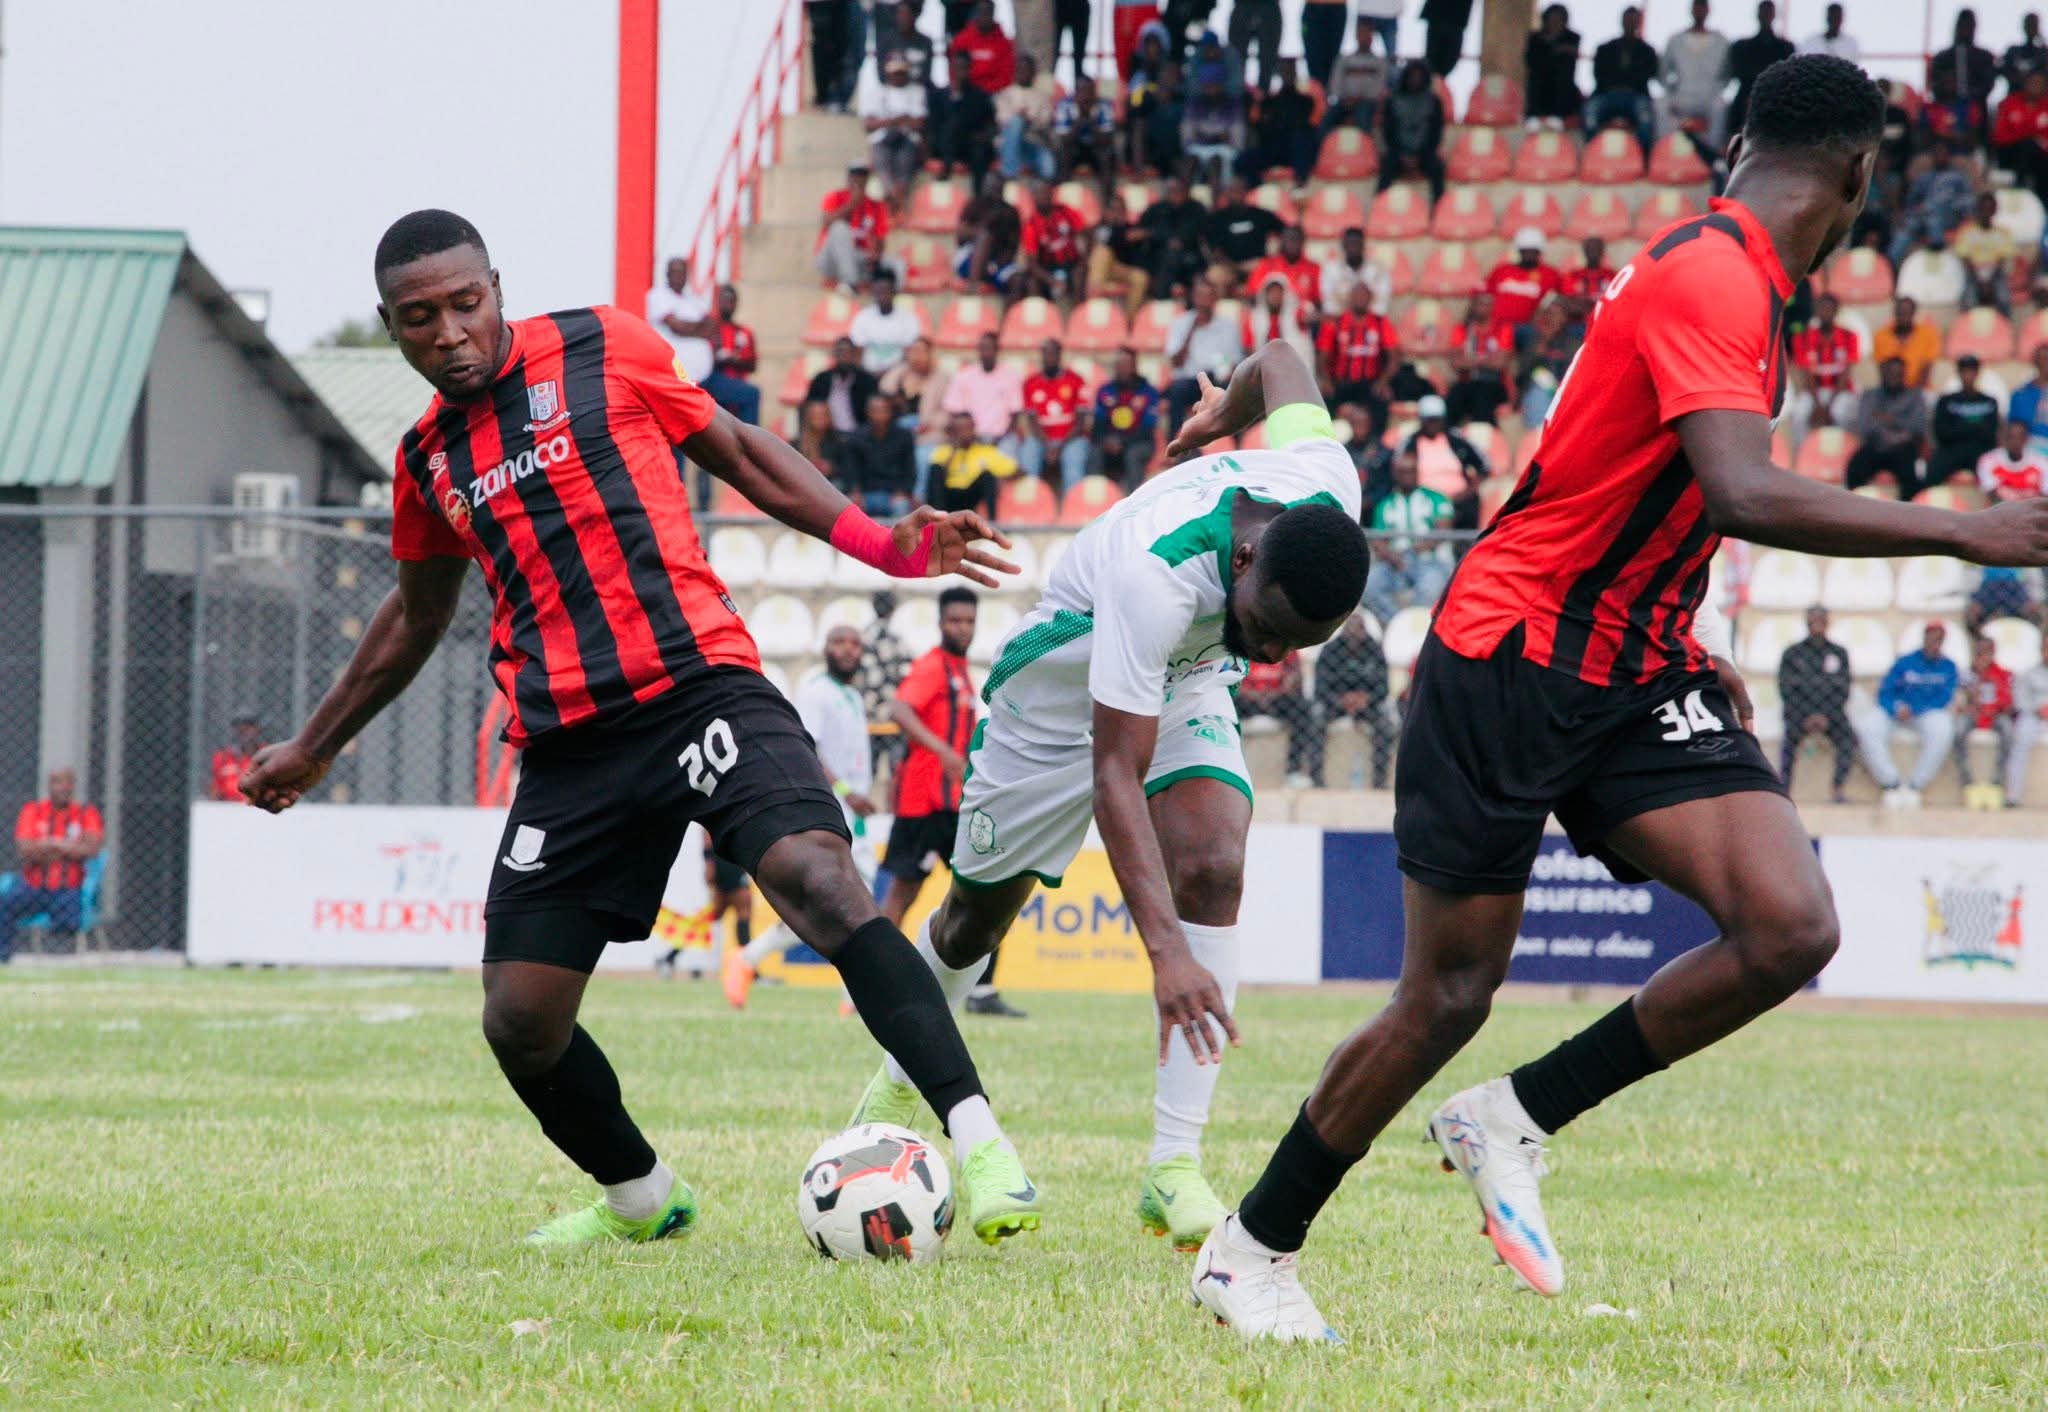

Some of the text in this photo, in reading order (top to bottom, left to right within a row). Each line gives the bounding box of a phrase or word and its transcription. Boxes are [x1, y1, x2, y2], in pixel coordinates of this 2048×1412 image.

[469, 435, 570, 509] zanaco
[1651, 689, 1725, 741] 34
[677, 717, 739, 798] 20
[1523, 886, 1653, 914] surance
